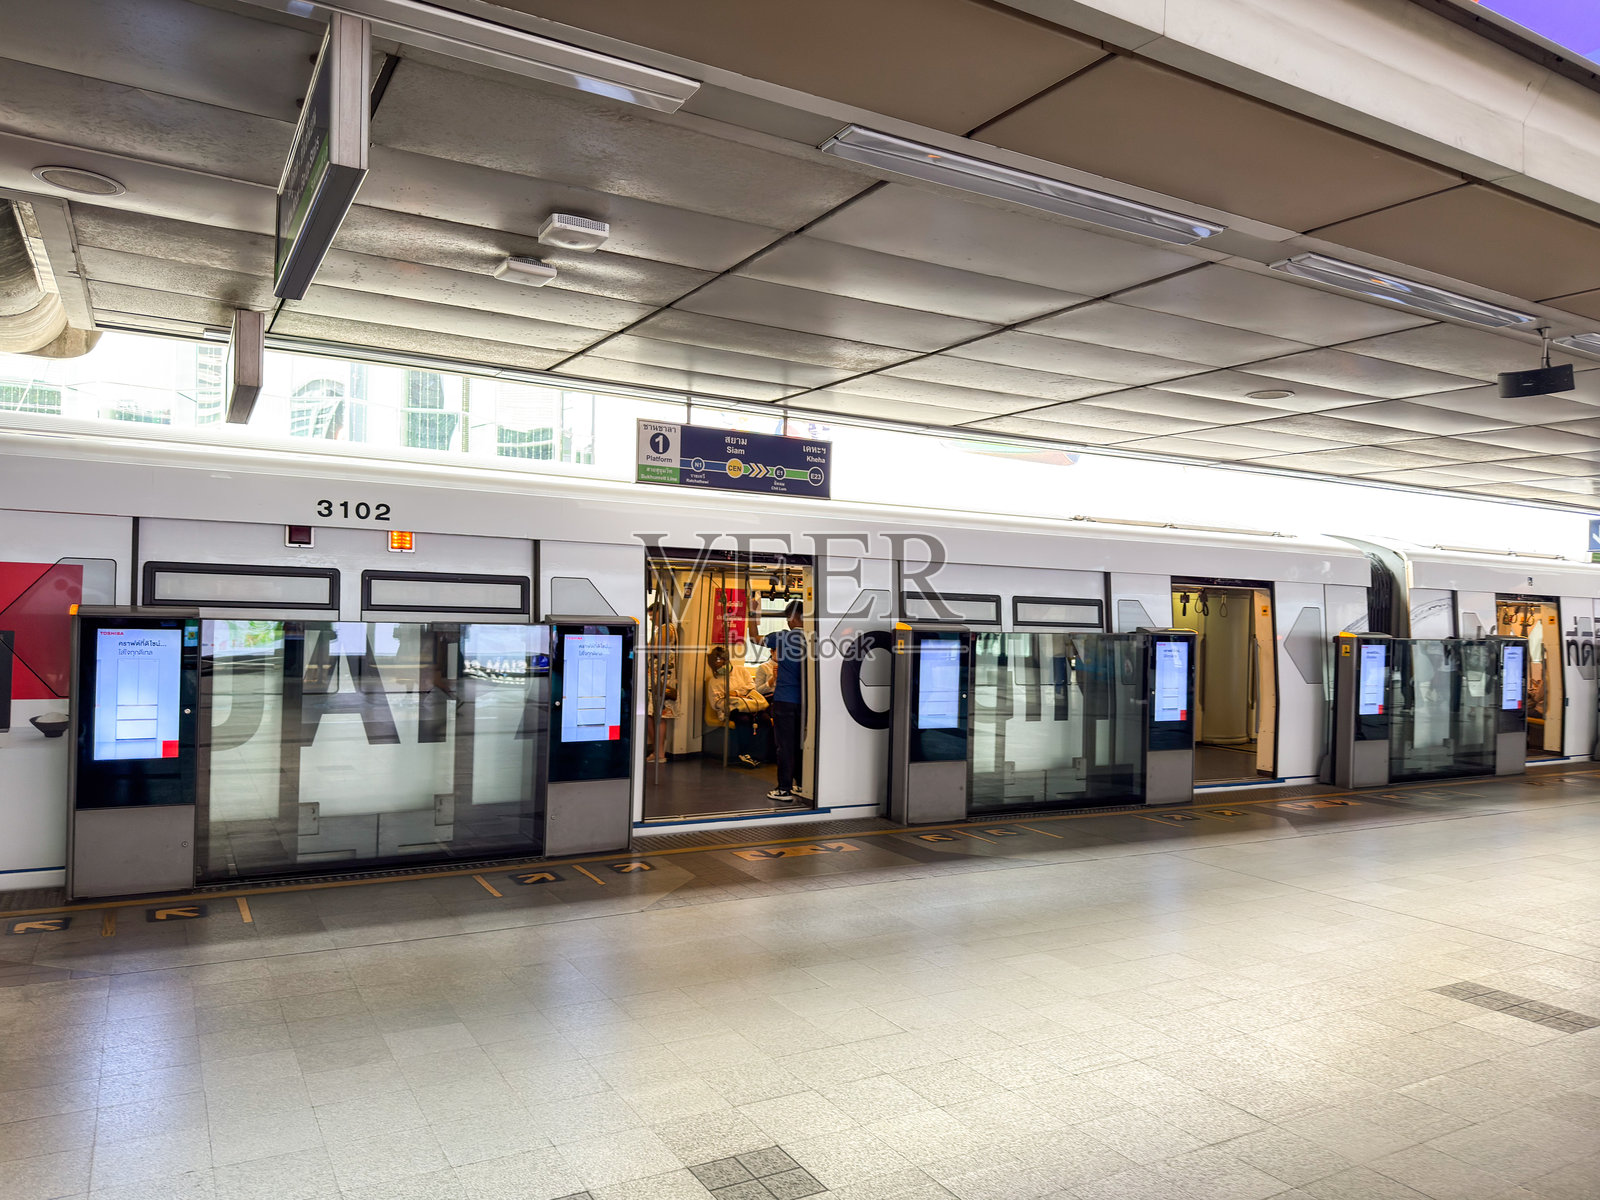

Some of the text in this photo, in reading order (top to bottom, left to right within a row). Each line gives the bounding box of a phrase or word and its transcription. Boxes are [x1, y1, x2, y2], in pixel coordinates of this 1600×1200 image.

[643, 424, 677, 433] ชานชาลา
[655, 435, 663, 452] 1
[724, 436, 747, 445] สยาม
[726, 446, 745, 455] Siam
[803, 445, 826, 454] เคหะฯ
[646, 455, 673, 463] Platform
[317, 499, 391, 521] 3102
